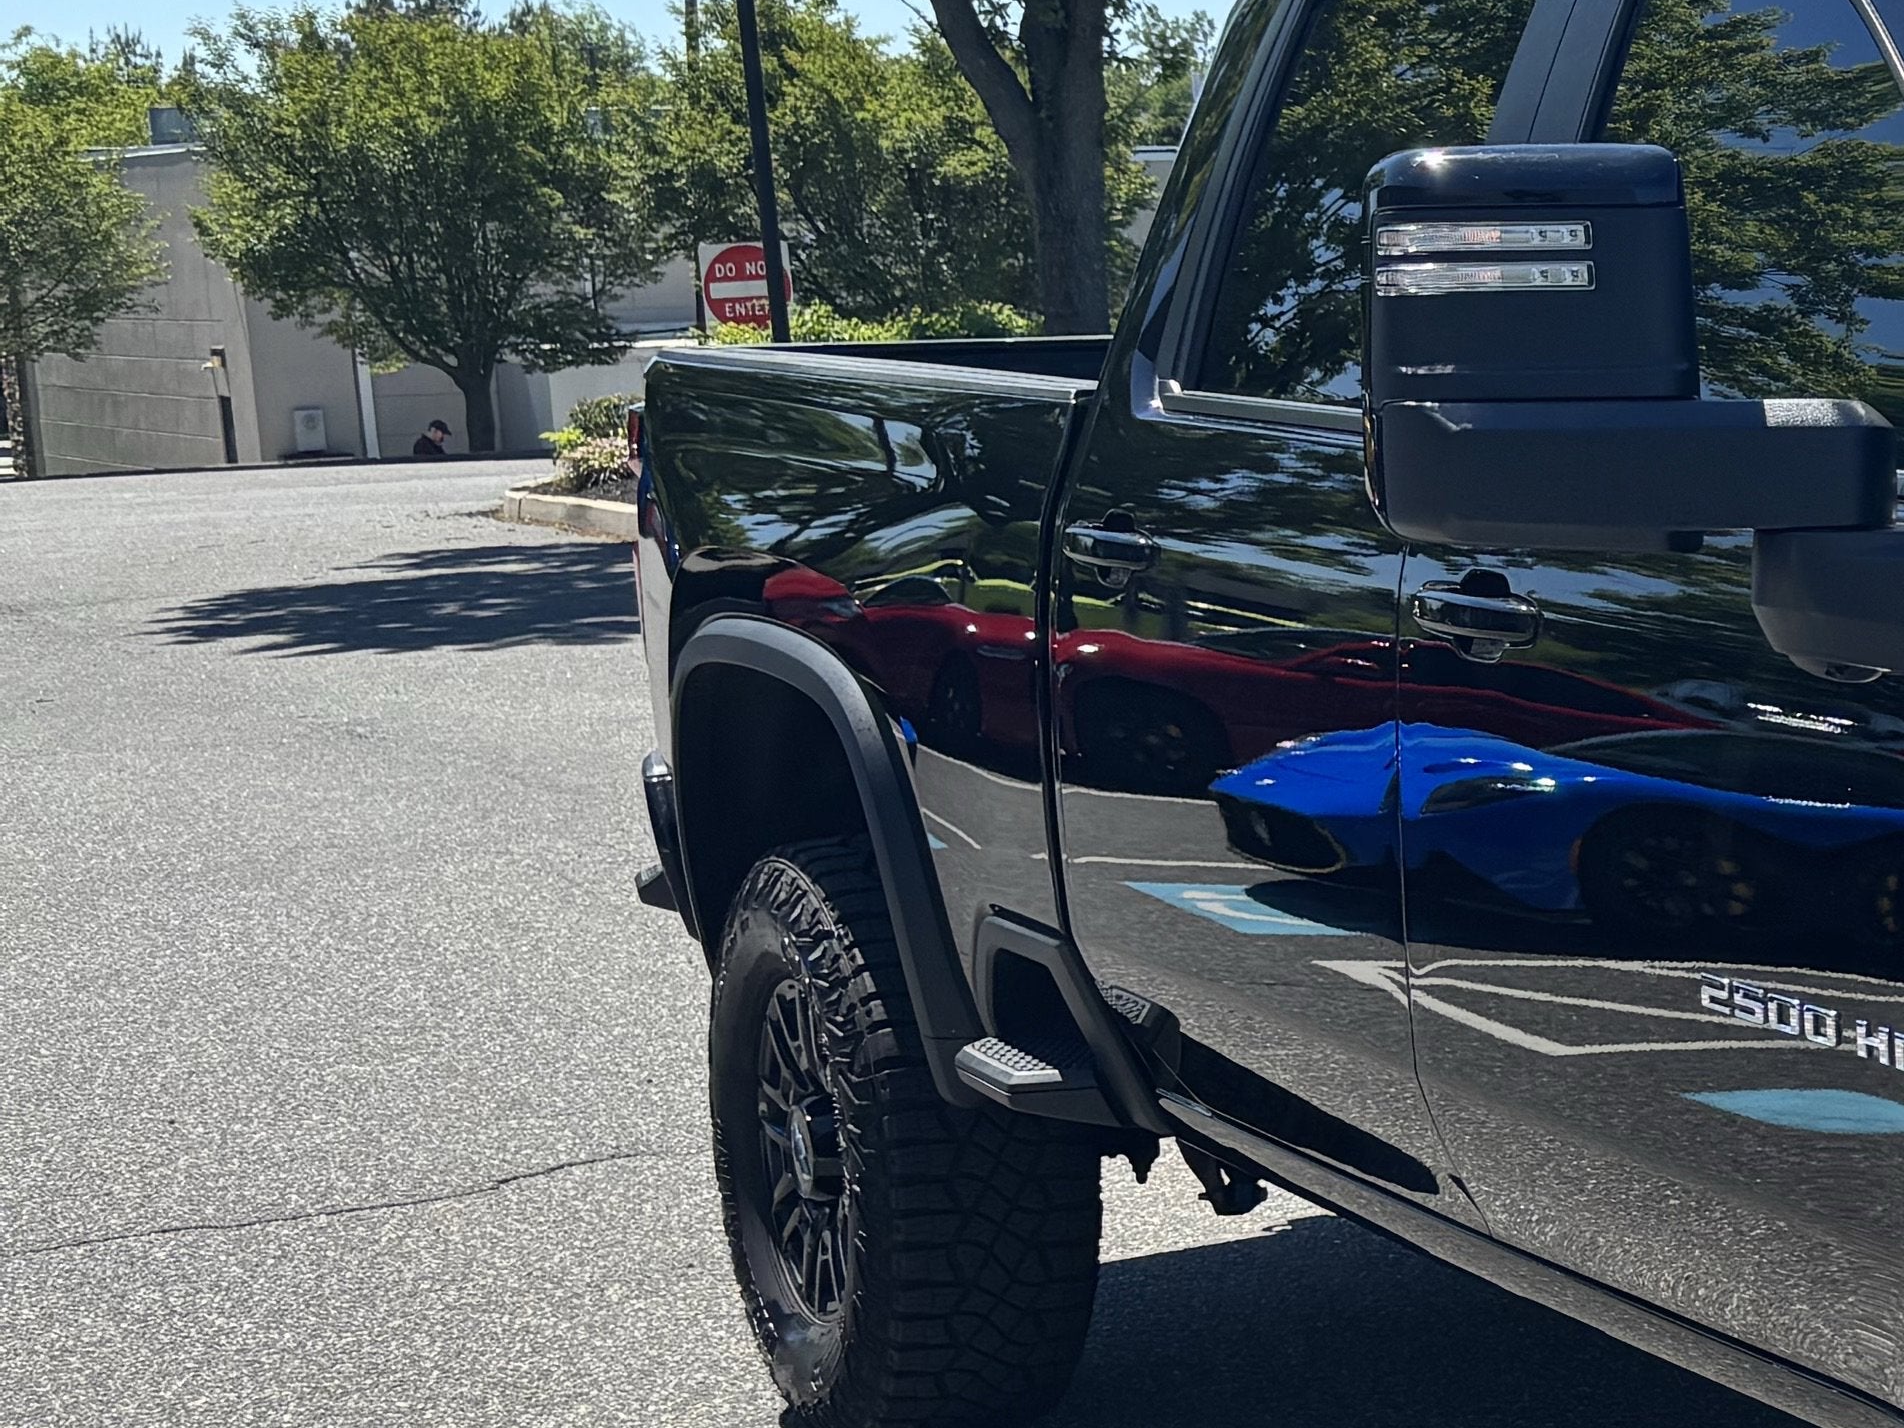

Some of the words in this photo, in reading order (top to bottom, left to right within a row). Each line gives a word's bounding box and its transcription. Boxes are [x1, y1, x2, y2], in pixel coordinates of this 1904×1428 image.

[715, 262, 736, 278] DO
[745, 260, 767, 276] NO
[1700, 972, 1840, 1047] 2500
